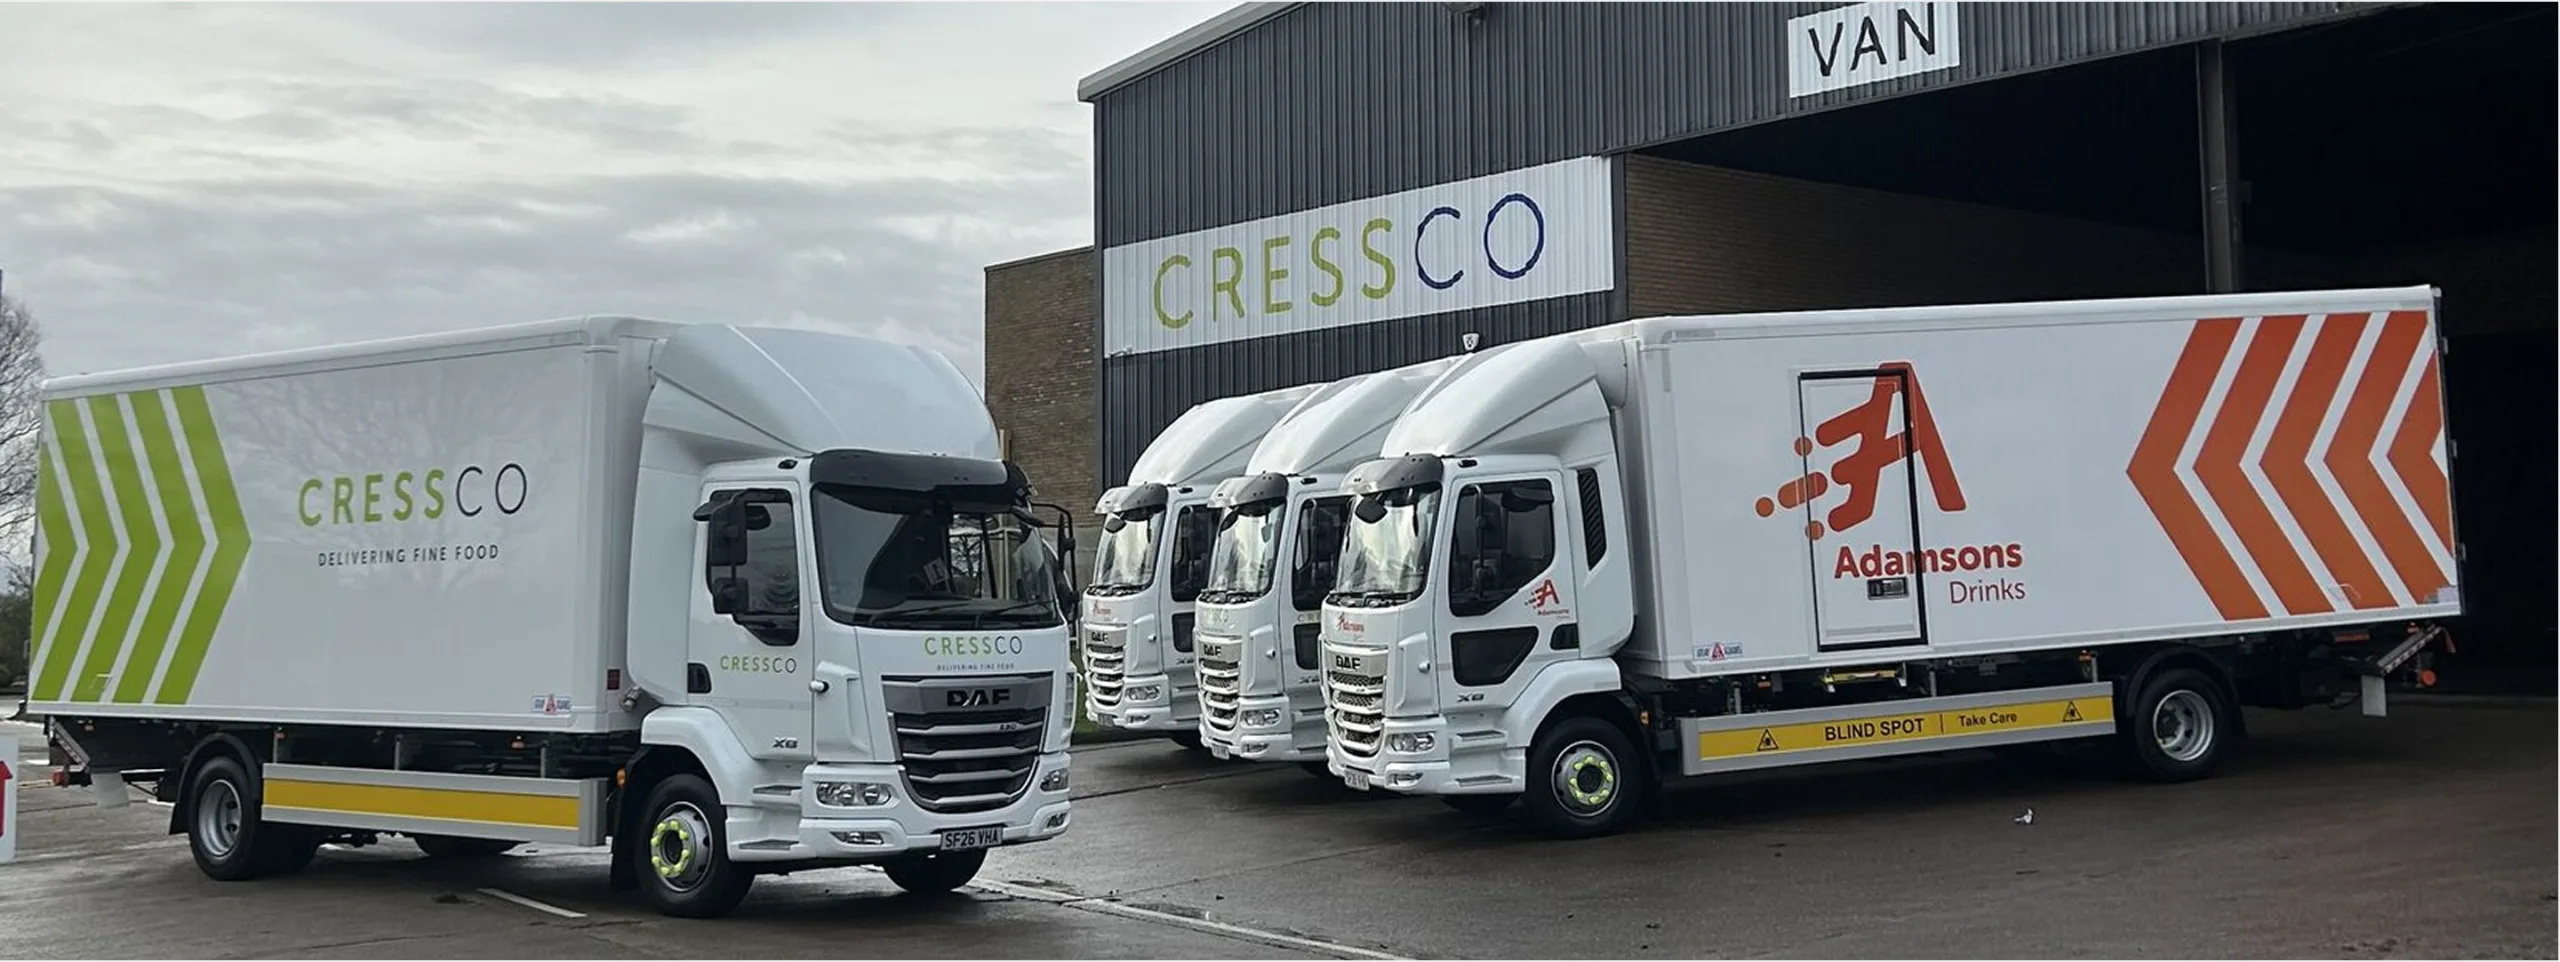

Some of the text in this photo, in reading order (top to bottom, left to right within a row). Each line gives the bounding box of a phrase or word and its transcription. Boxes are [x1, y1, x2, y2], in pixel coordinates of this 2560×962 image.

[1808, 2, 1935, 77] VAN
[1153, 192, 1546, 329] CRESSCO
[299, 463, 528, 527] CRESSCO
[318, 544, 499, 567] DELIVERING FINE FOOD
[1834, 543, 2023, 579] Adamsons
[1949, 578, 2026, 604] Drinks
[924, 635, 1023, 655] CRESSCO
[720, 656, 797, 674] CRESSCO
[1336, 655, 1361, 669] DAF
[946, 688, 1010, 707] DAF
[1825, 712, 2018, 741] BLIND SPOT Take Care
[944, 831, 976, 848] SF26
